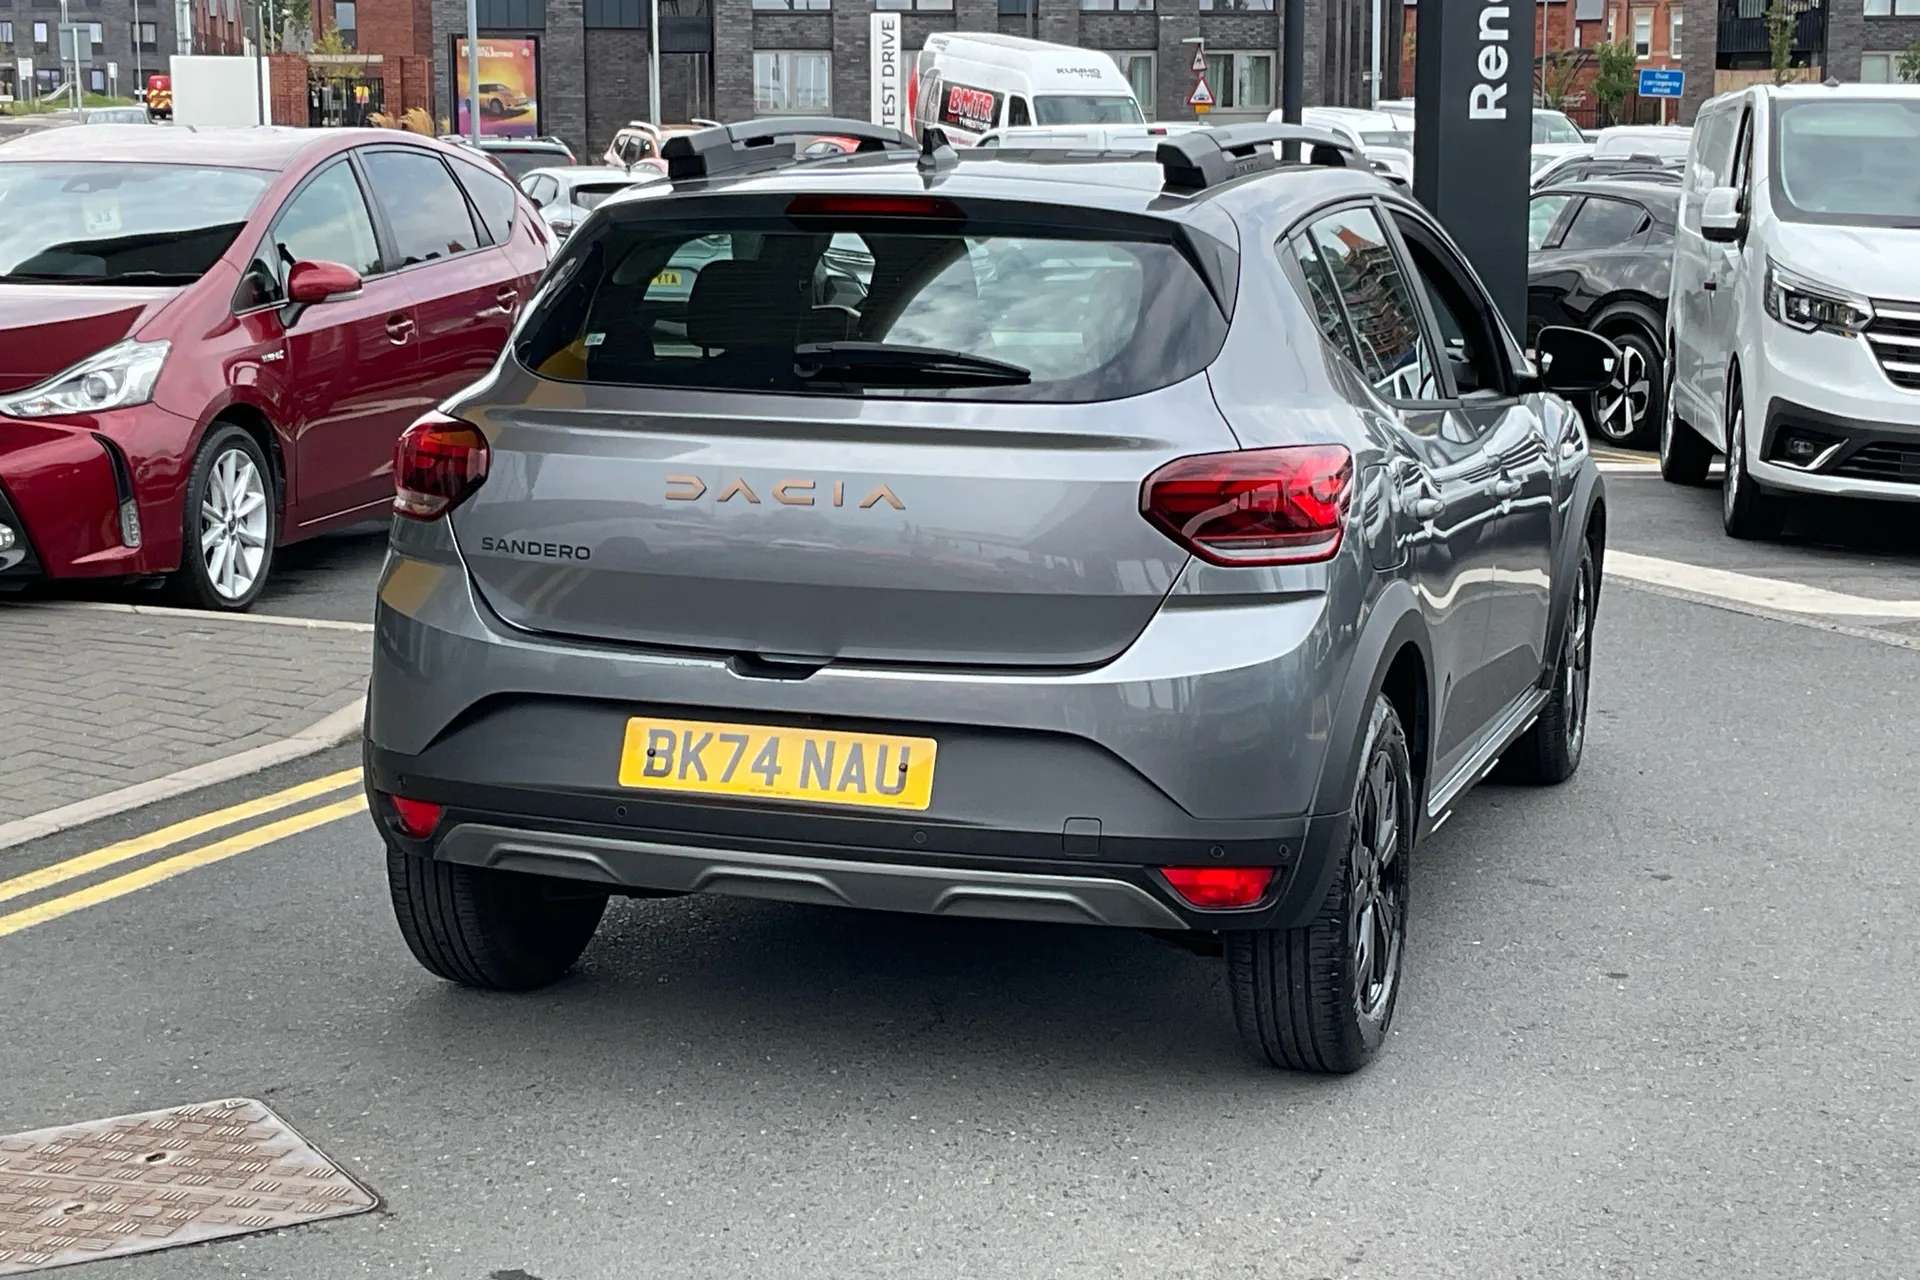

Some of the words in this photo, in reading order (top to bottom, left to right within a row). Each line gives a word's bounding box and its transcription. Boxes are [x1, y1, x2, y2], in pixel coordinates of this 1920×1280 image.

[882, 19, 895, 77] DRIVE
[1469, 0, 1509, 119] Ren
[882, 83, 895, 126] TEST
[948, 86, 994, 122] BMTR
[665, 474, 906, 510] DACIA
[481, 536, 591, 561] SANDERO
[643, 728, 782, 787] BK74
[799, 739, 911, 796] NAU
